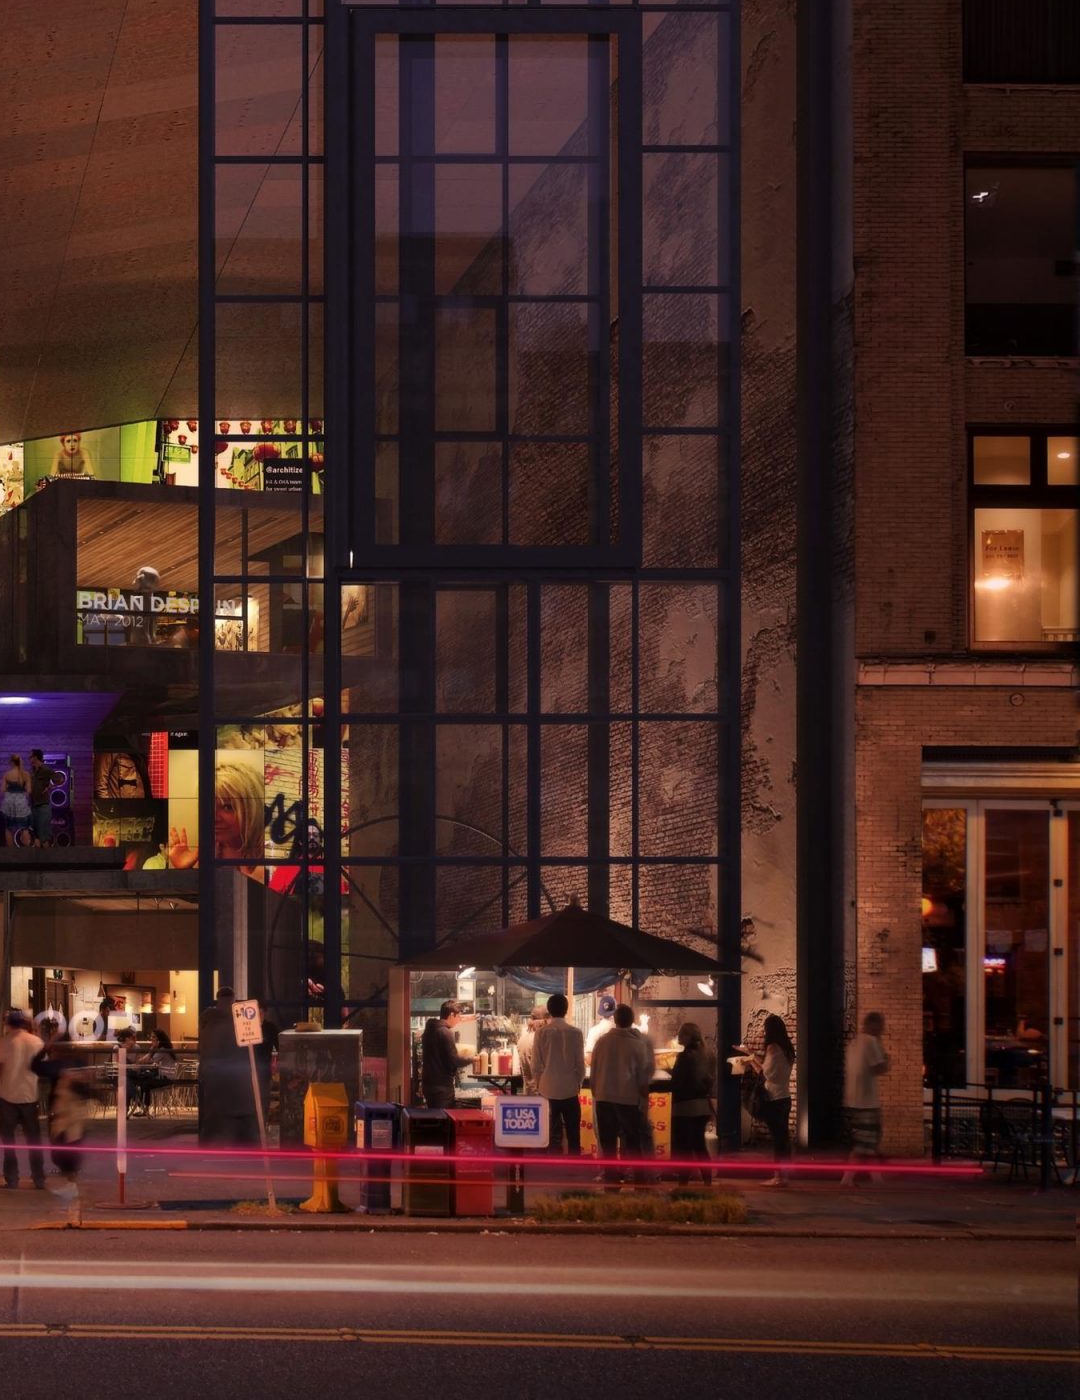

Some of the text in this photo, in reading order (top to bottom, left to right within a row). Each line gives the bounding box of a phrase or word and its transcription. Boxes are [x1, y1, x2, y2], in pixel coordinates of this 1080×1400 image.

[79, 591, 144, 612] BRIAN
[114, 614, 144, 628] 2012
[514, 1108, 536, 1119] USA
[503, 1118, 537, 1129] TODAY
